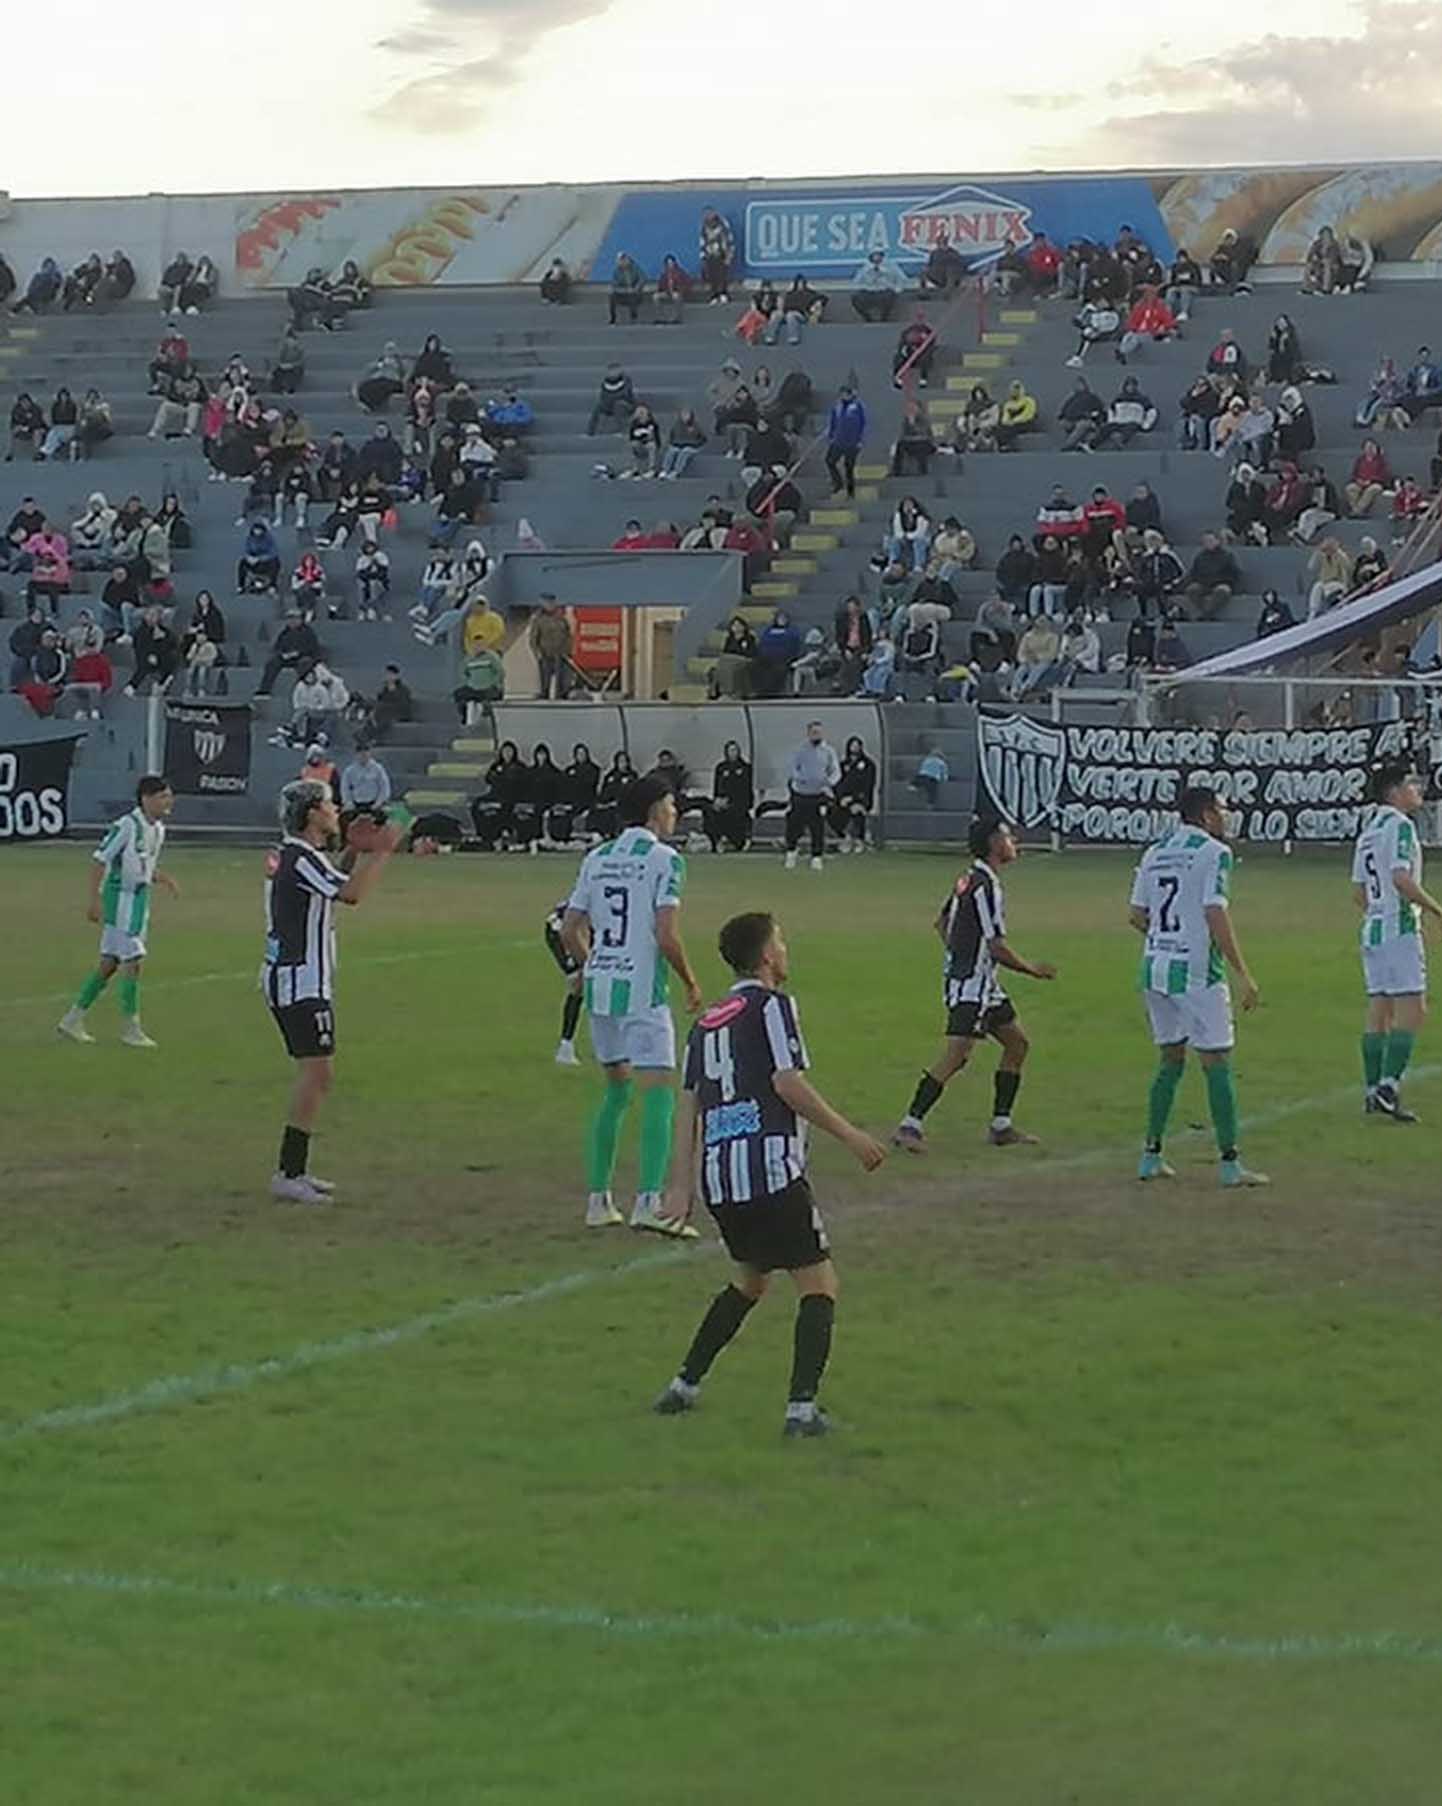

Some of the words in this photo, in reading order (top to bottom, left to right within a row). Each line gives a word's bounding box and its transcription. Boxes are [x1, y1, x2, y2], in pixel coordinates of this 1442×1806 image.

[757, 211, 818, 259] QUE
[827, 211, 890, 251] SEA
[902, 210, 1034, 246] FENIX
[1067, 726, 1220, 765] VOLVERE
[1222, 728, 1372, 767] SIEMPRE
[1066, 763, 1181, 803] VERTE
[1263, 768, 1368, 804] AMOR
[1060, 802, 1184, 841] PORQU
[1248, 809, 1289, 841] LO
[602, 884, 629, 949] 3
[703, 1024, 737, 1103] 4
